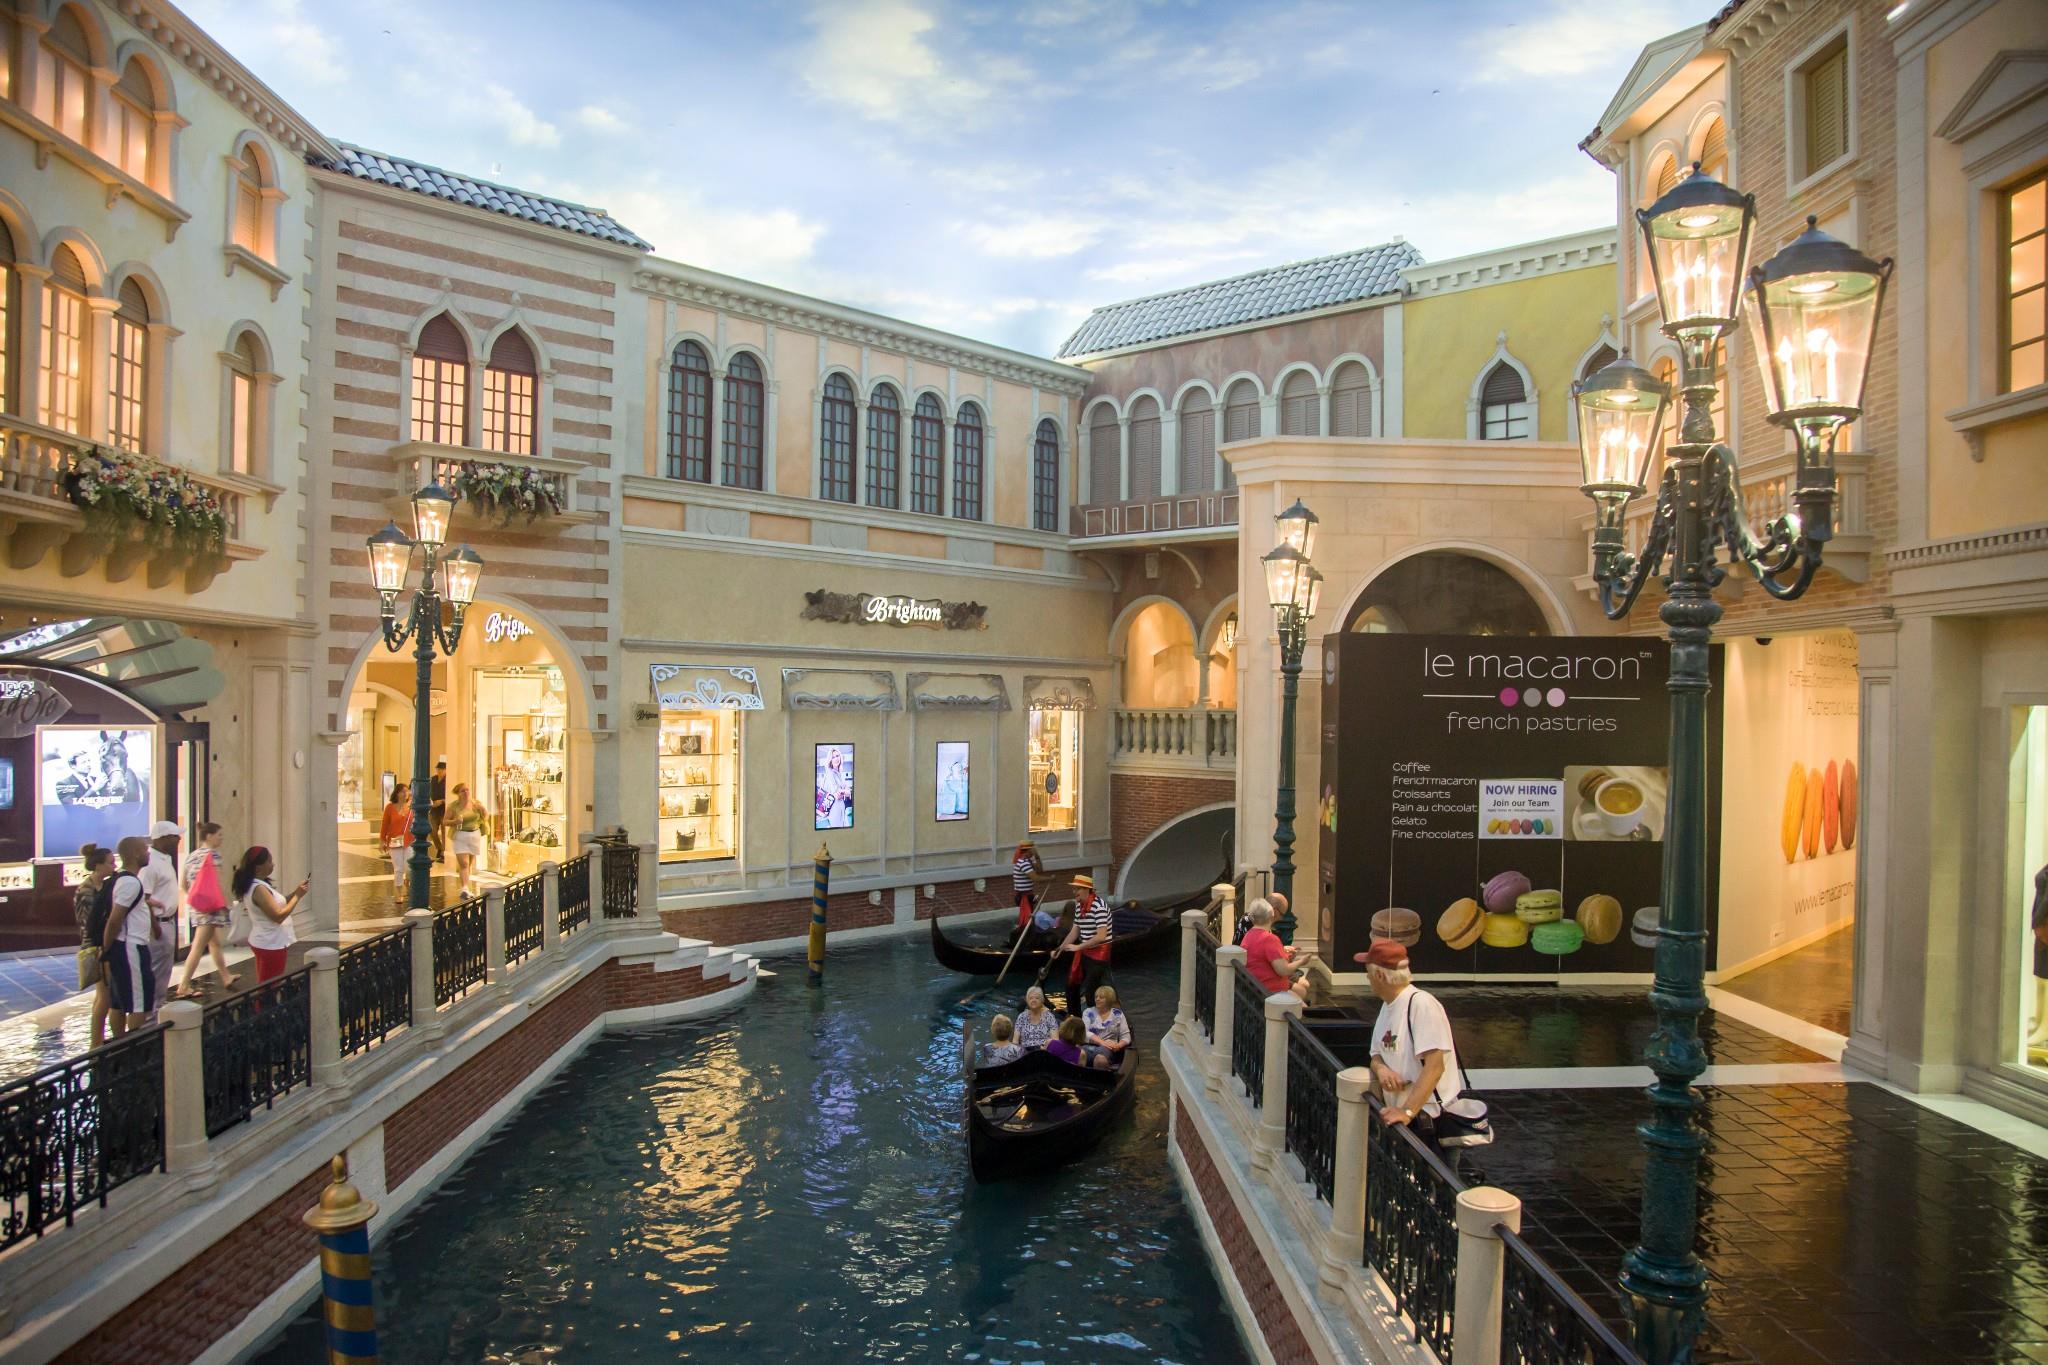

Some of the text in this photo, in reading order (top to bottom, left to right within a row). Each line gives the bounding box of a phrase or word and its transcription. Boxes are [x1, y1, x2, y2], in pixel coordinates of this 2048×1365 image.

[865, 596, 942, 624] Brighton
[1424, 647, 1455, 678] le
[1467, 654, 1640, 680] macaron
[1446, 711, 1617, 735] french pastries
[1392, 762, 1431, 774] Coffee
[1392, 775, 1430, 785] French
[1392, 789, 1451, 799] Croissants
[1485, 785, 1558, 795] NOW HIRING
[1392, 802, 1414, 812] Pain
[1416, 804, 1429, 812] au
[1431, 803, 1478, 812] chocolat
[1492, 799, 1510, 807] Join
[1527, 799, 1550, 807] Team
[1391, 816, 1428, 826] Gelato
[1392, 829, 1474, 839] Fine chocolates
